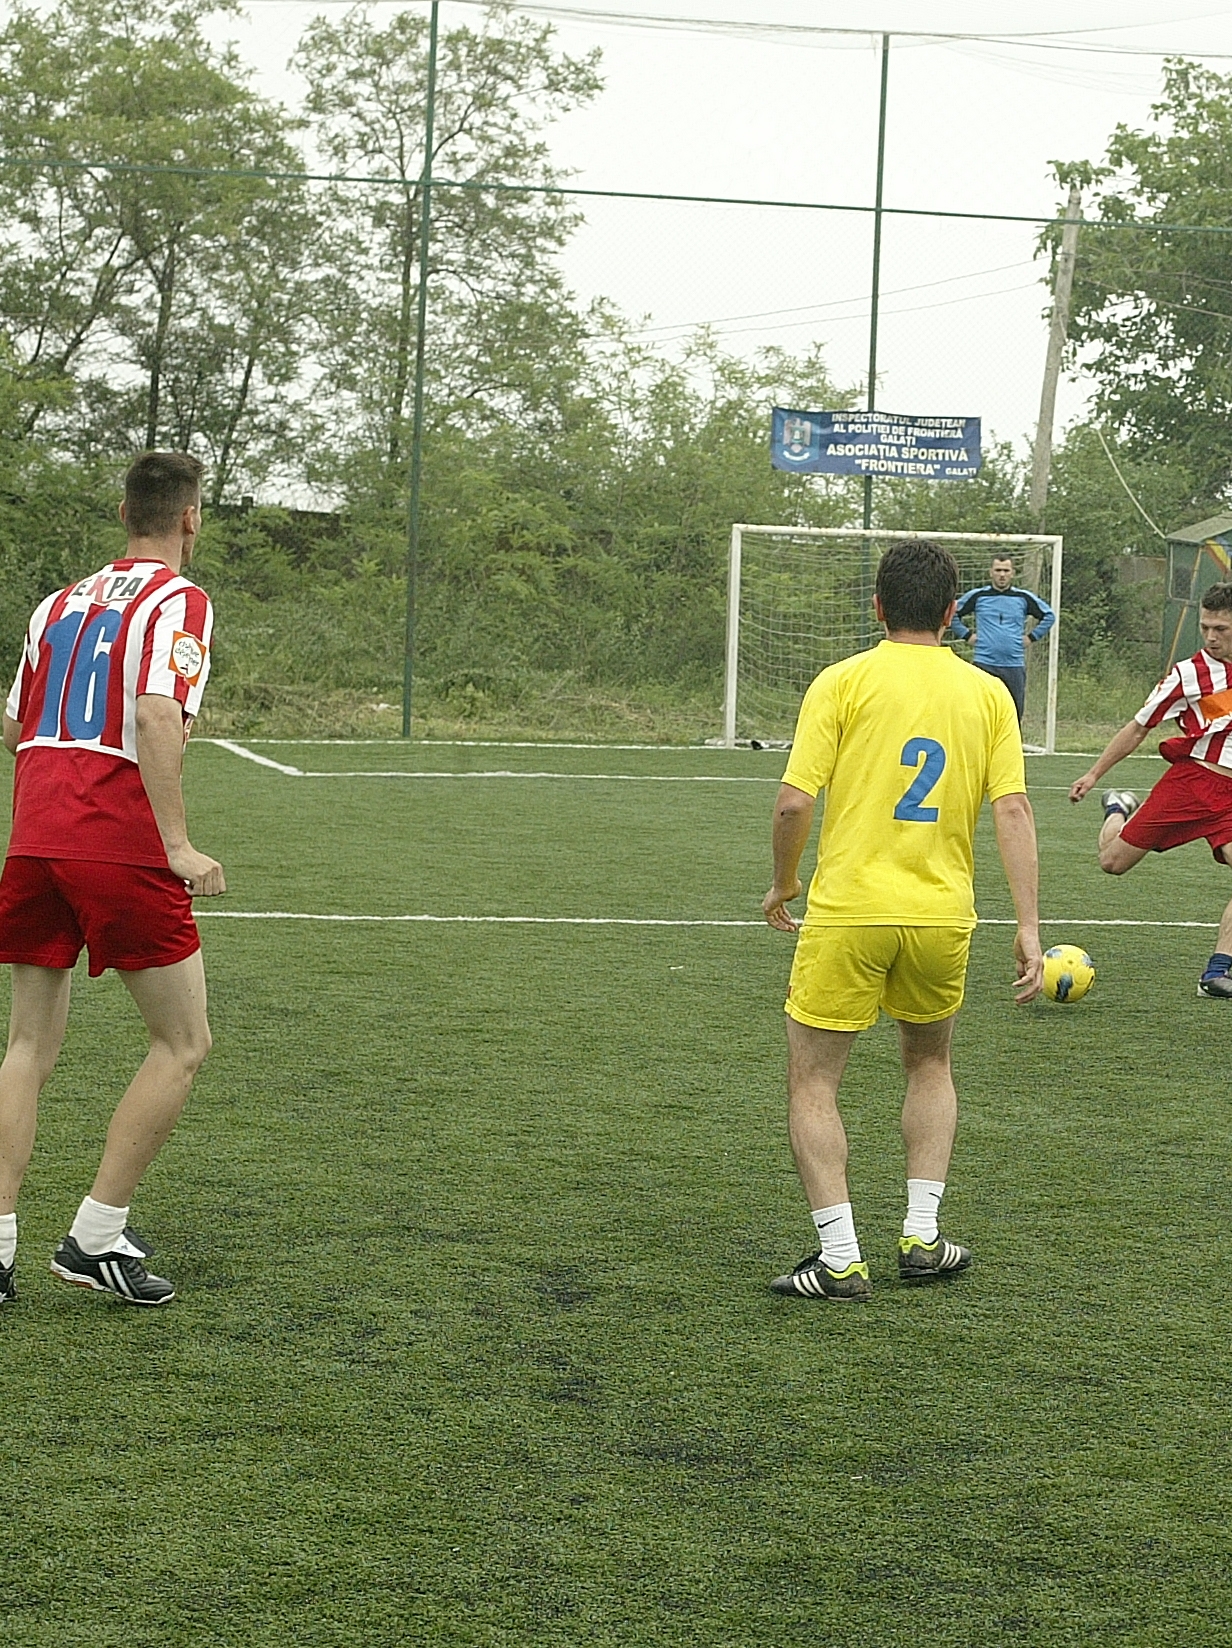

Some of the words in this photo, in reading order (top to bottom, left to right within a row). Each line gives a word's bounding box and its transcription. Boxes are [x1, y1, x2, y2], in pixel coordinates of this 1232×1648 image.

[832, 413, 912, 425] INSPECTORATUL
[833, 424, 846, 433] AL
[892, 426, 906, 435] DE
[35, 608, 123, 741] 16
[893, 736, 947, 823] 2
